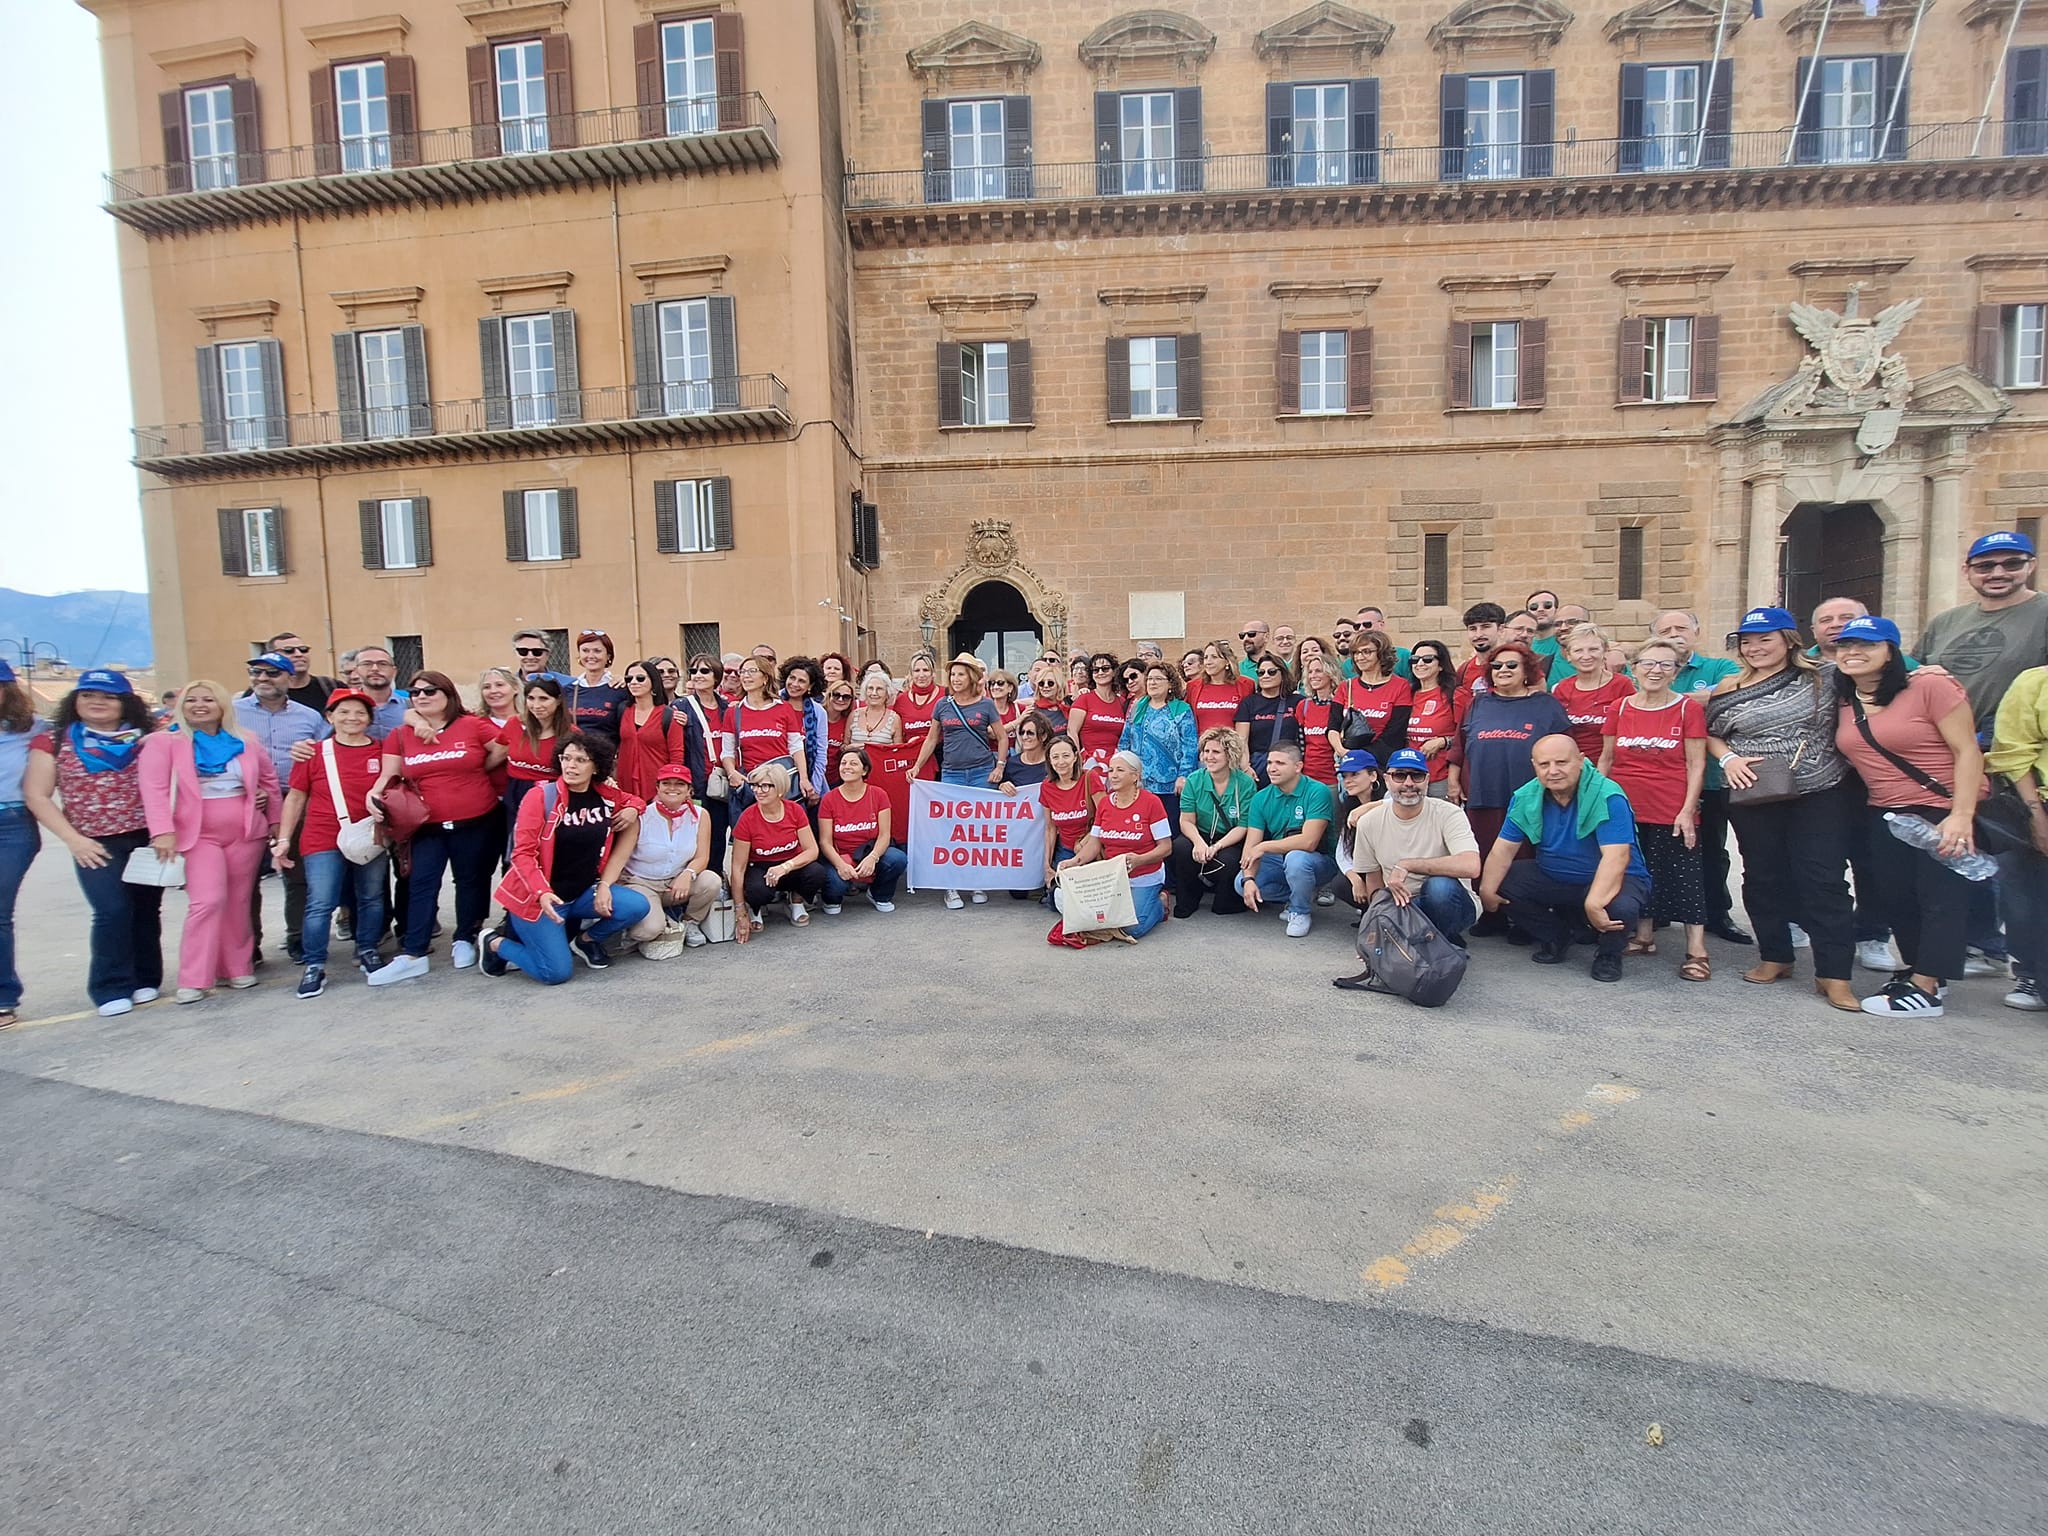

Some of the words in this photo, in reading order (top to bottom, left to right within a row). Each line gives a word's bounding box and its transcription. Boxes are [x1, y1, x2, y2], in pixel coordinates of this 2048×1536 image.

[1746, 613, 1765, 621] UIL
[1477, 729, 1531, 740] BelleCiao
[1617, 736, 1680, 749] BelleCiao
[1401, 750, 1417, 758] UIL
[929, 796, 1035, 819] DIGNITÁ
[950, 824, 1008, 843] ALLE
[932, 847, 1024, 868] DONNE
